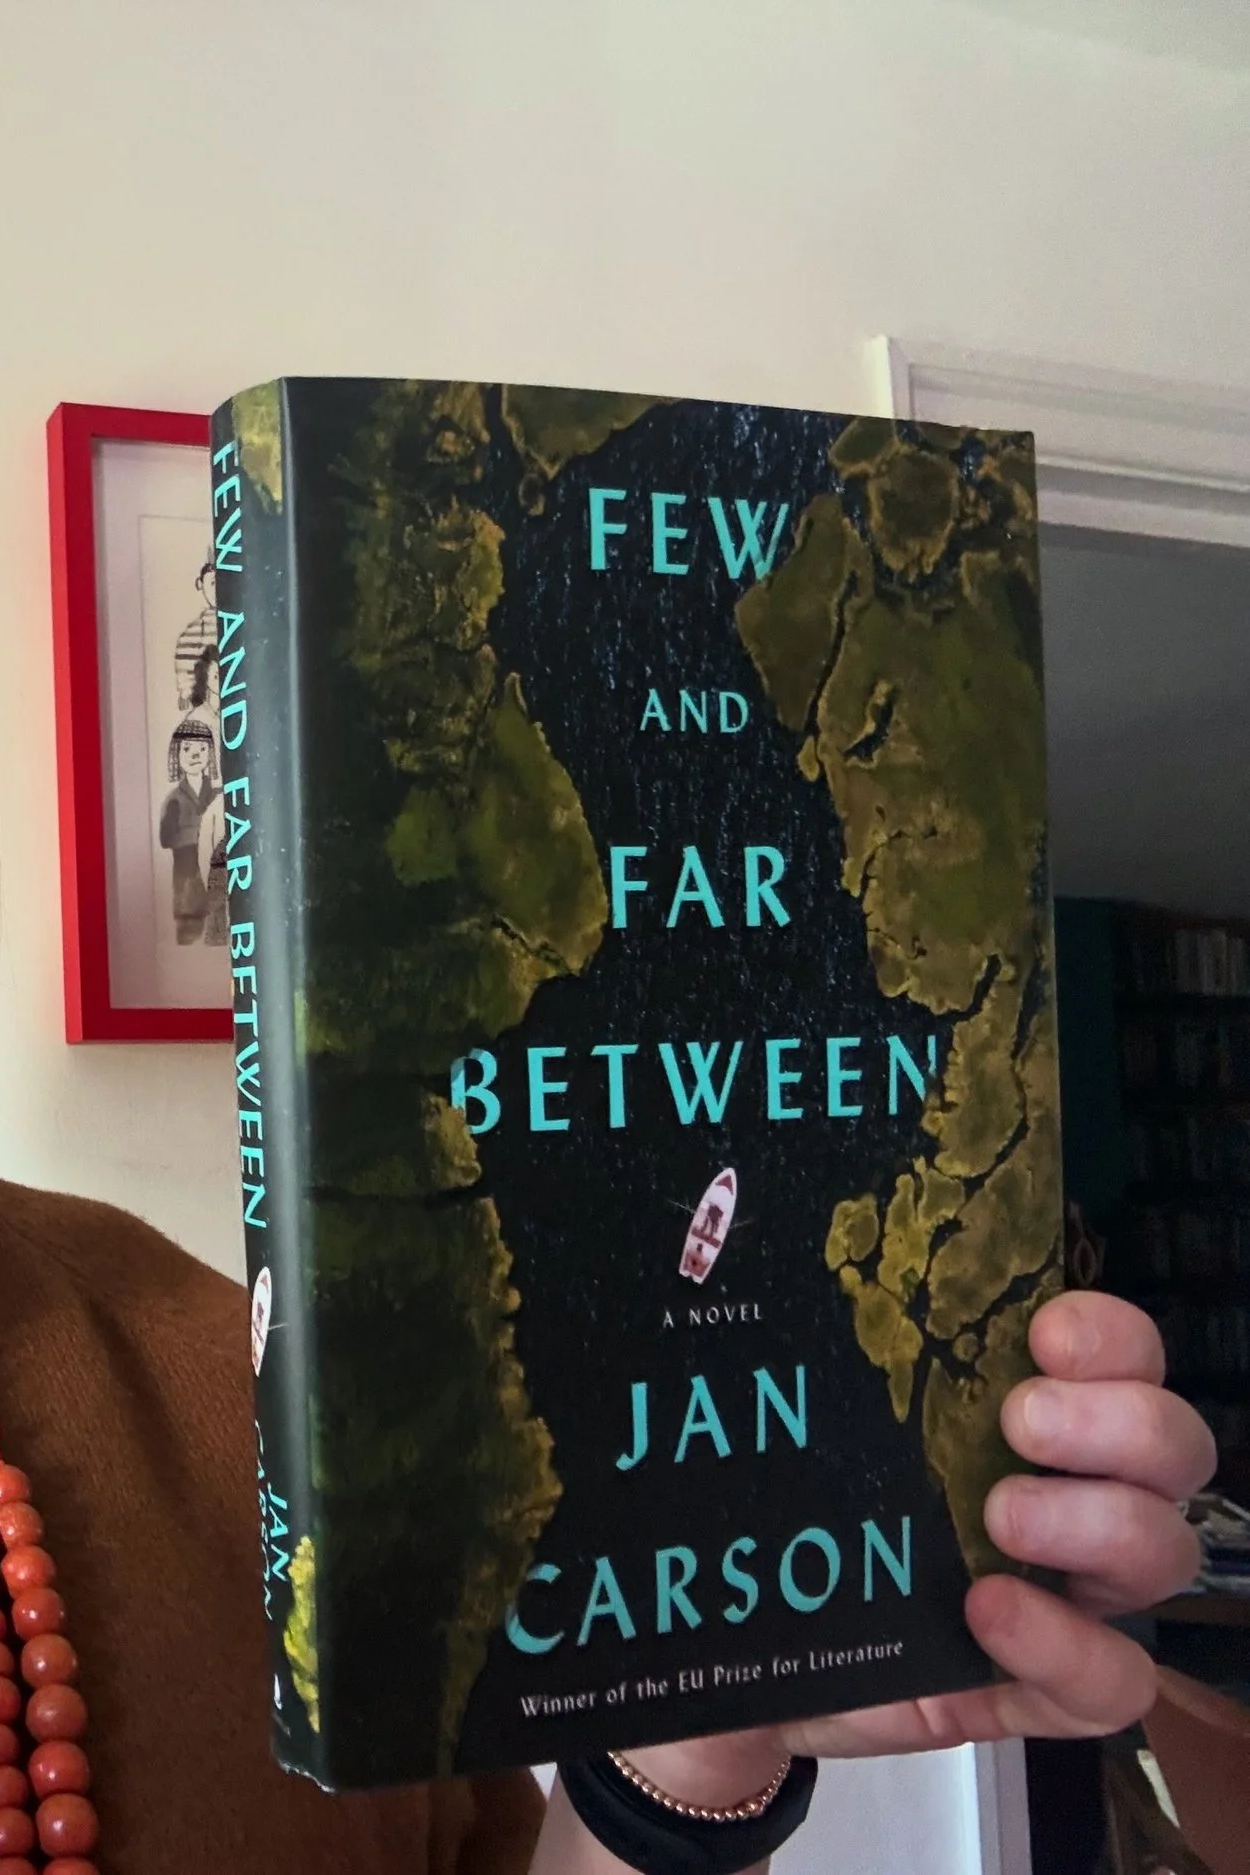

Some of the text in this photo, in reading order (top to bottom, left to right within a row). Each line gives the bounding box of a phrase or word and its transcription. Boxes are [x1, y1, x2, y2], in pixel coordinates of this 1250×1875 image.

[589, 487, 790, 581] FEW
[639, 687, 749, 734] AND
[213, 440, 267, 1229] FEW AND FAR BETWEEN
[609, 845, 792, 930] FAR
[450, 1035, 937, 1135] BETWEEN
[662, 1302, 762, 1328] A NOVEL
[615, 1364, 810, 1472] JAN
[267, 1481, 291, 1582] JAN
[505, 1516, 913, 1655] CARSON
[520, 1641, 904, 1718] Winner of the EU Prize for Literature
